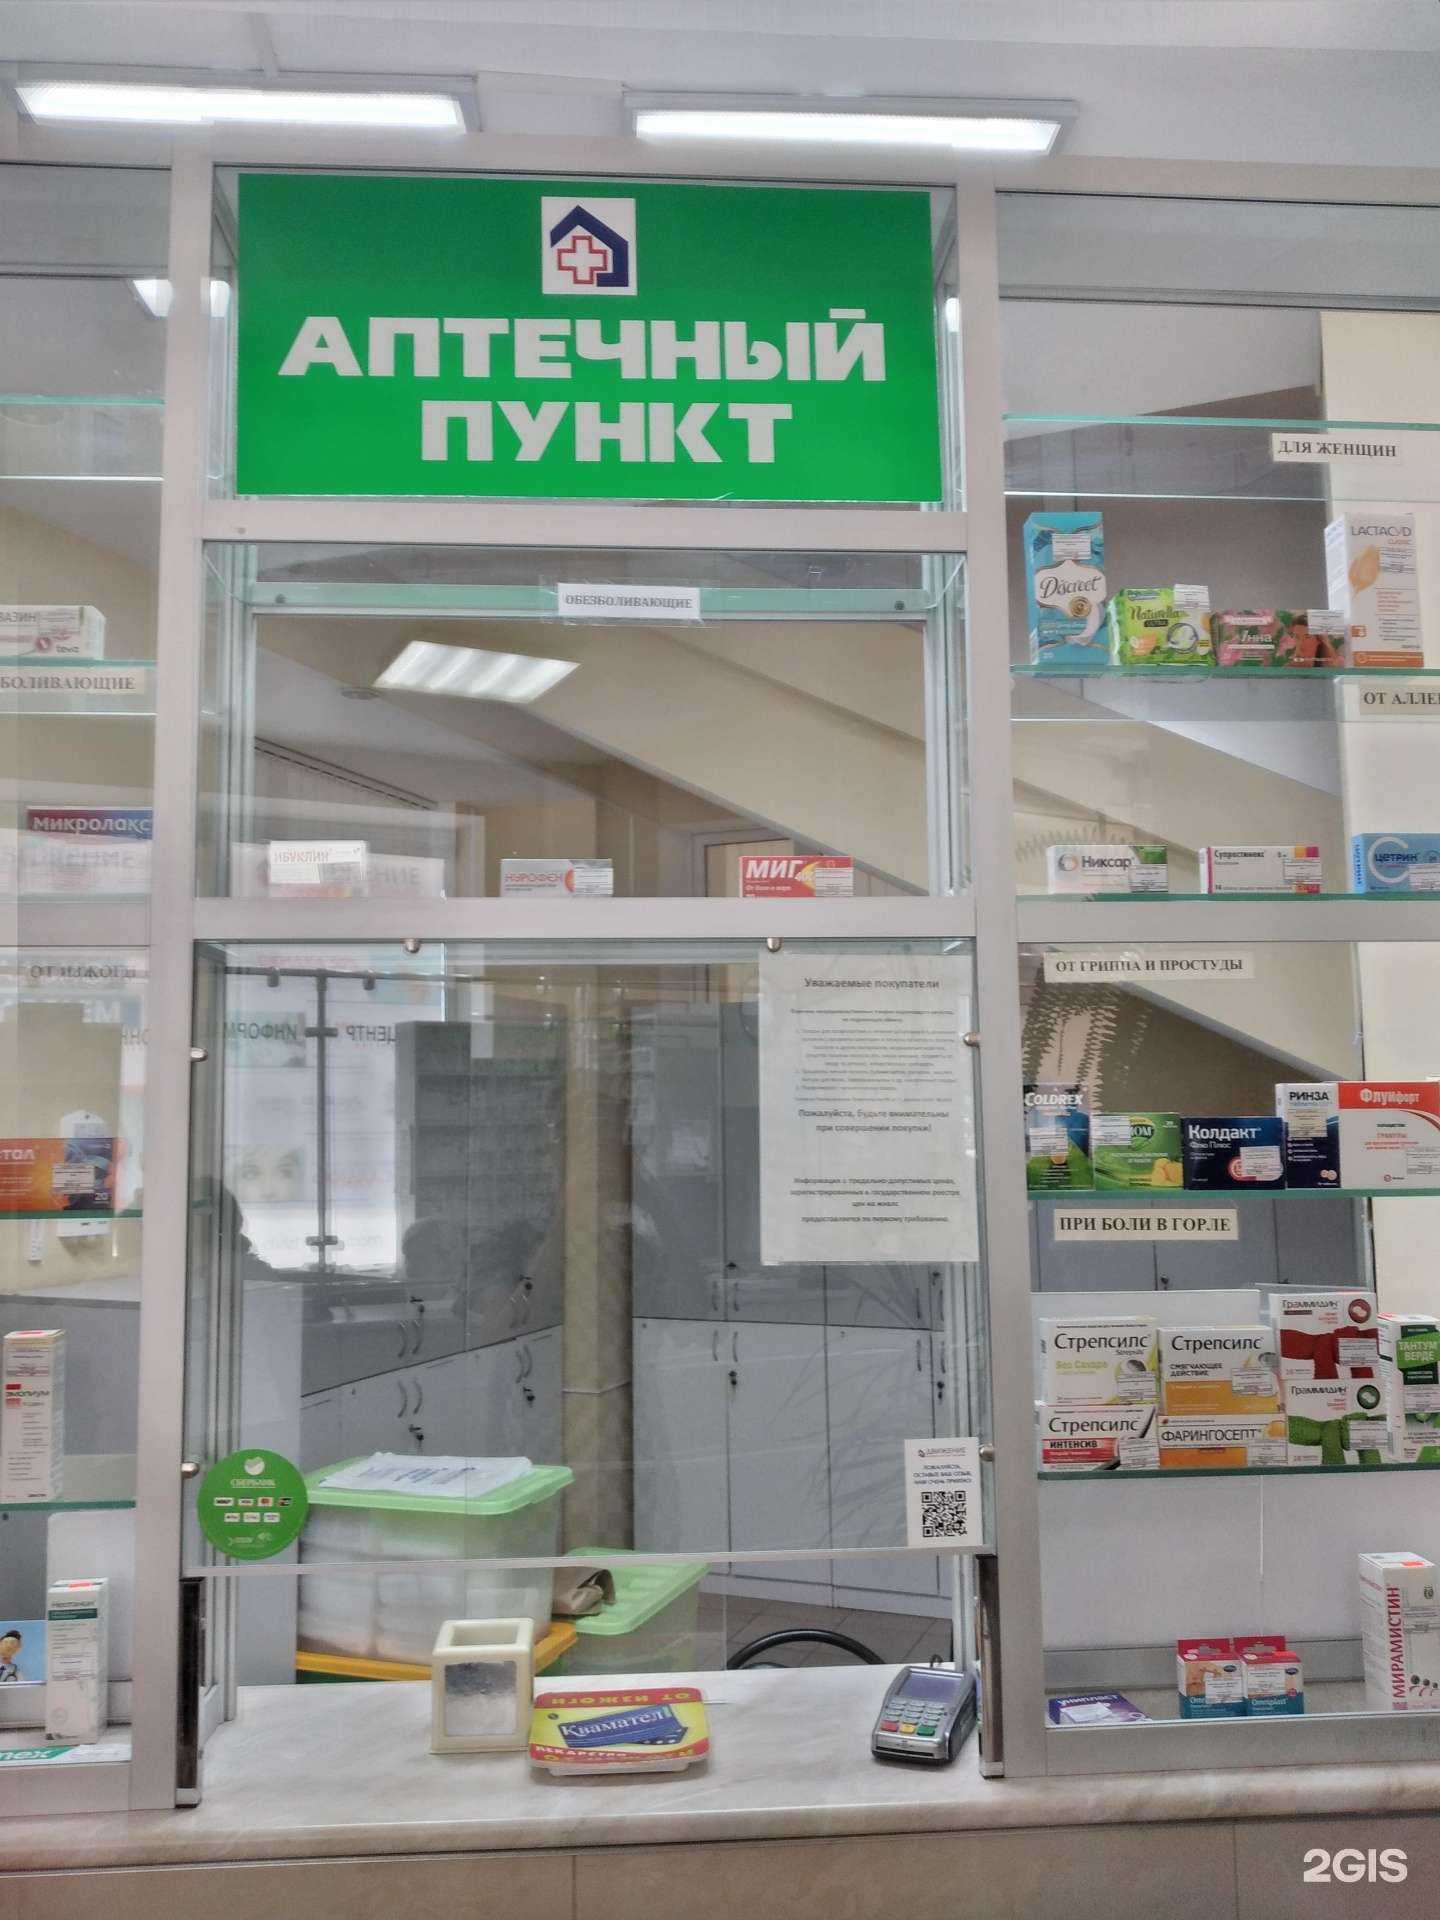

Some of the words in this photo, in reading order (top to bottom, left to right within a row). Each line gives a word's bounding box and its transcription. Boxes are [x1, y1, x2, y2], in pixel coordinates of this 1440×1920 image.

[278, 308, 887, 381] АПТЕЧНЫЙ
[421, 400, 793, 463] ПУНКТ
[1278, 440, 1312, 454] ДЛЯ
[1317, 442, 1397, 458] ЖЕНЩИН
[1040, 576, 1101, 599] Discreet
[566, 594, 693, 609] ОБЕЗБОЛИВАЮЩИЕ
[0, 676, 136, 690] БОЛИВАЮЩИЕ
[1363, 692, 1387, 705] ОТ
[33, 816, 151, 835] Микролакс
[273, 850, 330, 863] ИБУКЛИН
[1081, 855, 1132, 870] Никсар
[746, 859, 803, 879] МИГ
[1056, 961, 1076, 972] ОТ
[1080, 960, 1141, 972] ГРИППА
[1144, 960, 1156, 971] И
[1160, 959, 1243, 972] ПРОСТУДЫ
[804, 977, 873, 988] Уважаемые
[874, 978, 940, 989] покупатели
[1289, 1091, 1330, 1102] РИНЗА
[1188, 1125, 1259, 1141] Колдакт
[1060, 1217, 1096, 1231] ПРИ
[1101, 1217, 1151, 1231] БОЛИ
[1157, 1218, 1167, 1230] В
[1172, 1217, 1231, 1231] ГОРЛЕ
[1054, 1333, 1149, 1352] Стрепсилс
[1171, 1335, 1263, 1354] Стрепсилс
[1049, 1417, 1139, 1435] Стрепсилс
[1161, 1429, 1257, 1442] ФАРИНГОСЕПТ
[1050, 1440, 1098, 1449] ИНТЕНСИВ
[1386, 1587, 1406, 1699] МИРАМИСТИН
[561, 1710, 664, 1737] Квамател
